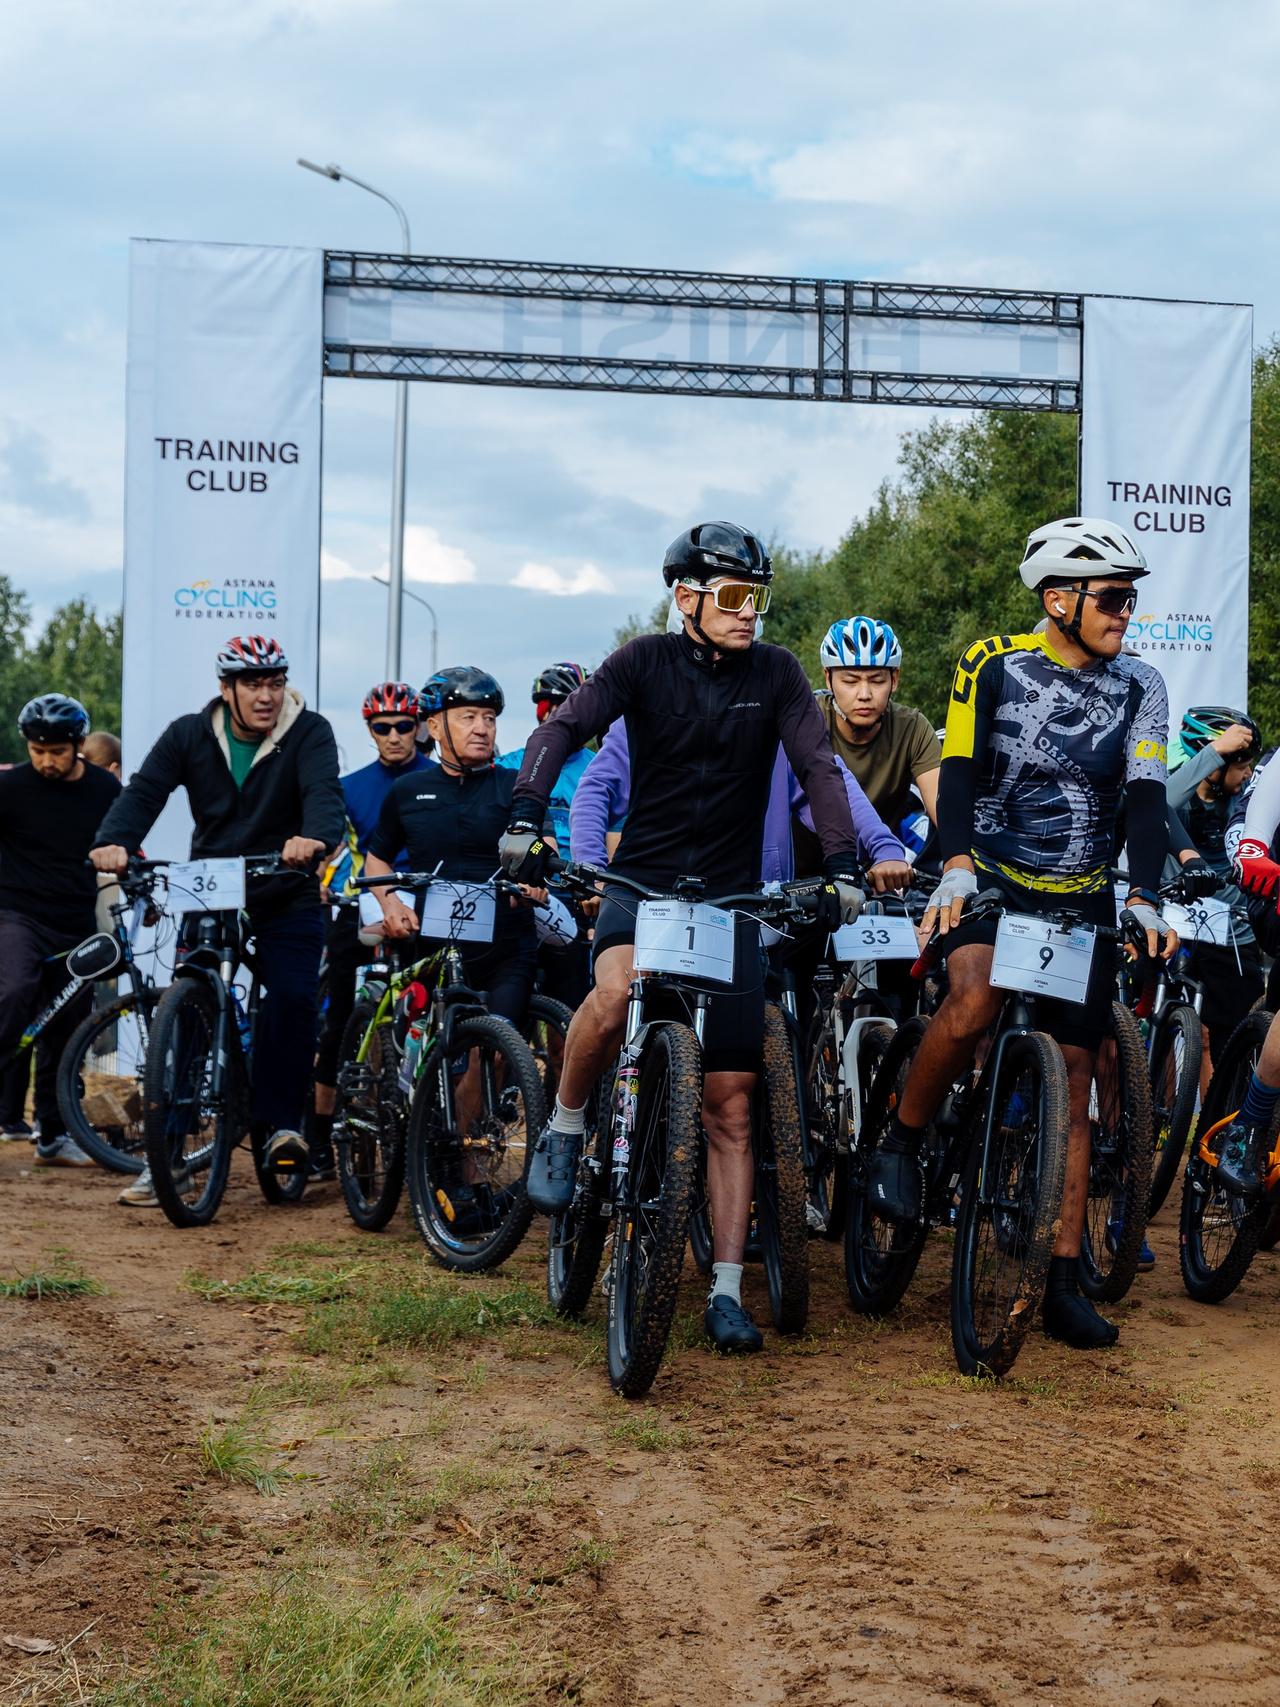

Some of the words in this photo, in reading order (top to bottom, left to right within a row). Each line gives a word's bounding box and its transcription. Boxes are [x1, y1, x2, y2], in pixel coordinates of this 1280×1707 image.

[154, 437, 299, 464] TRAINING
[187, 469, 268, 493] CLUB
[1107, 481, 1232, 507] TRAINING
[1133, 511, 1206, 533] CLUB
[223, 579, 276, 588] ASTANA
[174, 588, 277, 608] CYCLING
[175, 608, 277, 619] FEDERATION
[1166, 613, 1212, 623] ASTANA
[529, 746, 548, 782] ENDURA
[193, 875, 217, 892] 36
[450, 900, 476, 921] 22
[685, 925, 696, 951] 1
[861, 929, 891, 945] 33
[1039, 946, 1054, 971] 9
